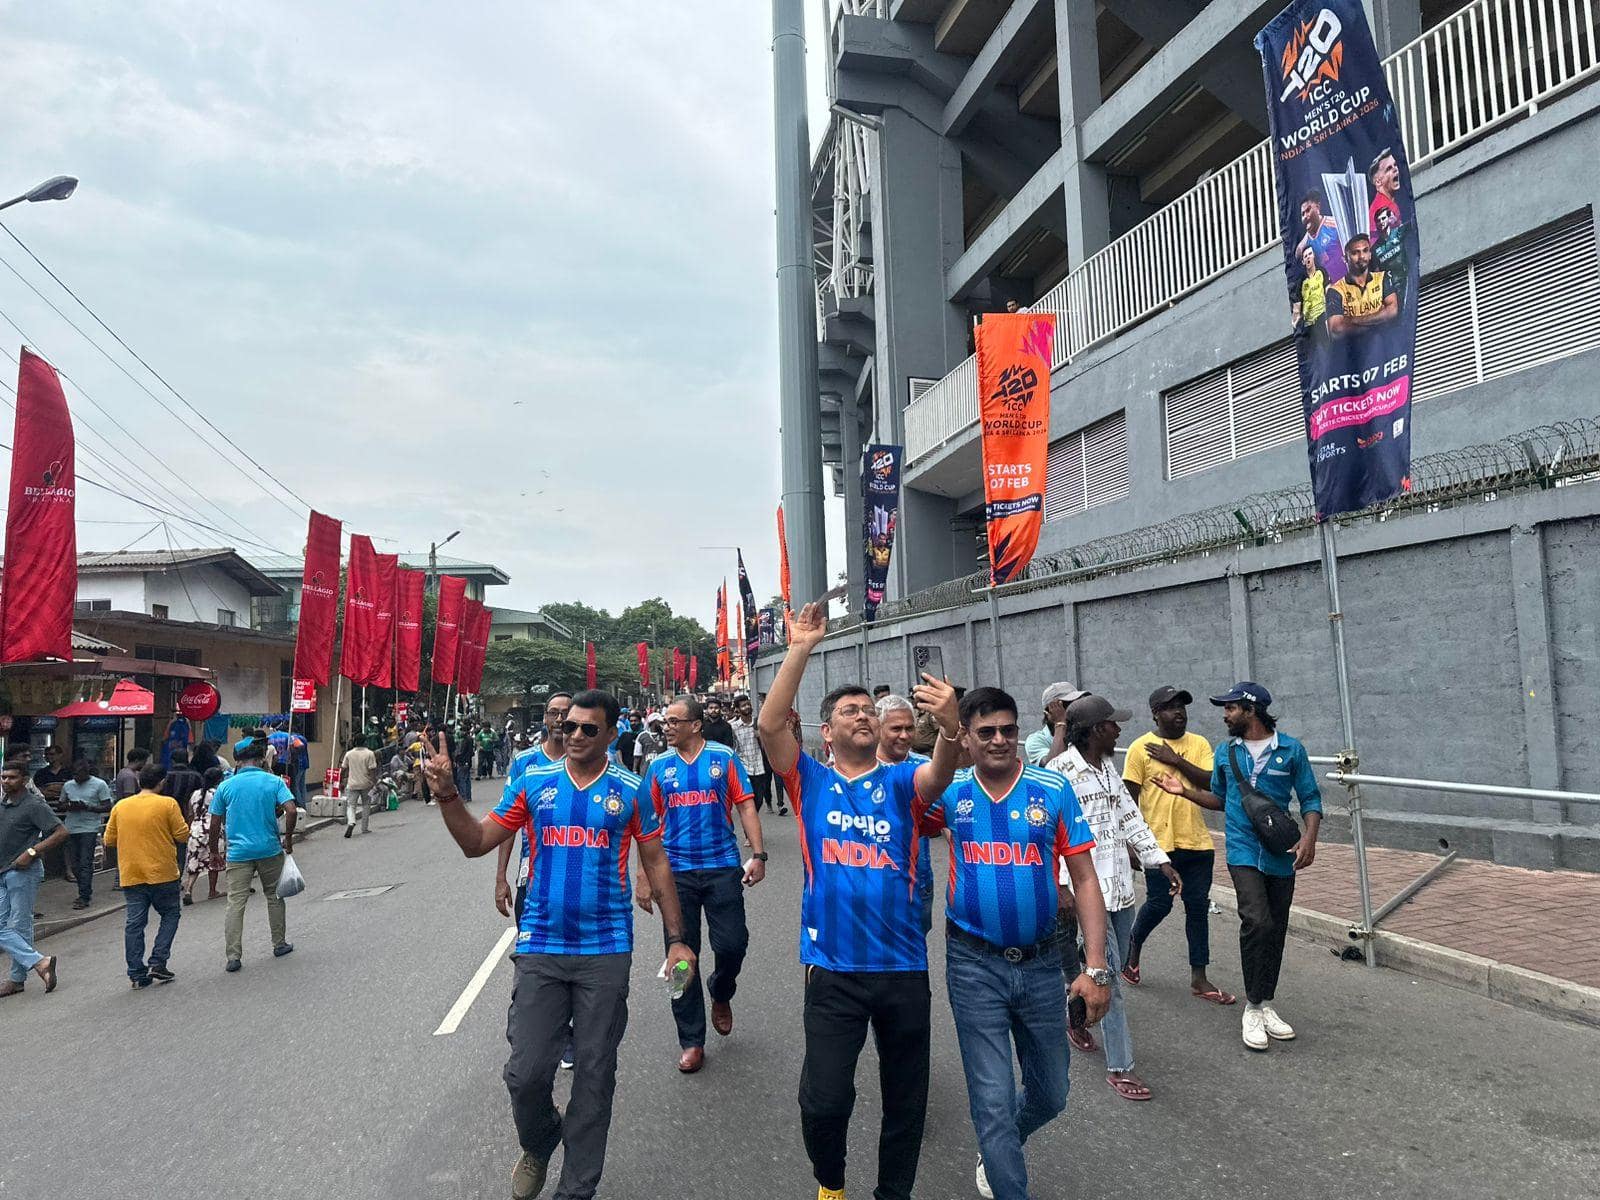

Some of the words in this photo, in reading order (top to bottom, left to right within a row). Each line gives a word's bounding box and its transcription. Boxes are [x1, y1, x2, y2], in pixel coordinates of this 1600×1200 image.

[1309, 80, 1332, 105] ICC
[1304, 102, 1331, 123] MEN'S
[1331, 91, 1345, 106] T20
[1281, 109, 1339, 150] WORLD
[1340, 86, 1370, 115] CUP
[1280, 145, 1305, 161] NDIA
[1360, 297, 1382, 314] LANK
[1311, 374, 1361, 404] STARTS
[1362, 366, 1379, 384] 07
[1383, 354, 1408, 378] FEB
[1007, 402, 1023, 411] ICC
[1331, 394, 1374, 415] TICKETS
[1376, 383, 1402, 402] NOW
[1021, 420, 1042, 429] CUP
[988, 463, 1032, 475] STARTS
[24, 486, 75, 498] BELLAGIO
[990, 479, 1004, 489] 07
[1007, 477, 1029, 488] FEB
[1021, 495, 1039, 507] NOW
[668, 789, 719, 808] INDIA
[542, 826, 610, 848] INDIA
[822, 838, 900, 871] INDIA
[962, 841, 1044, 866] INDIA
